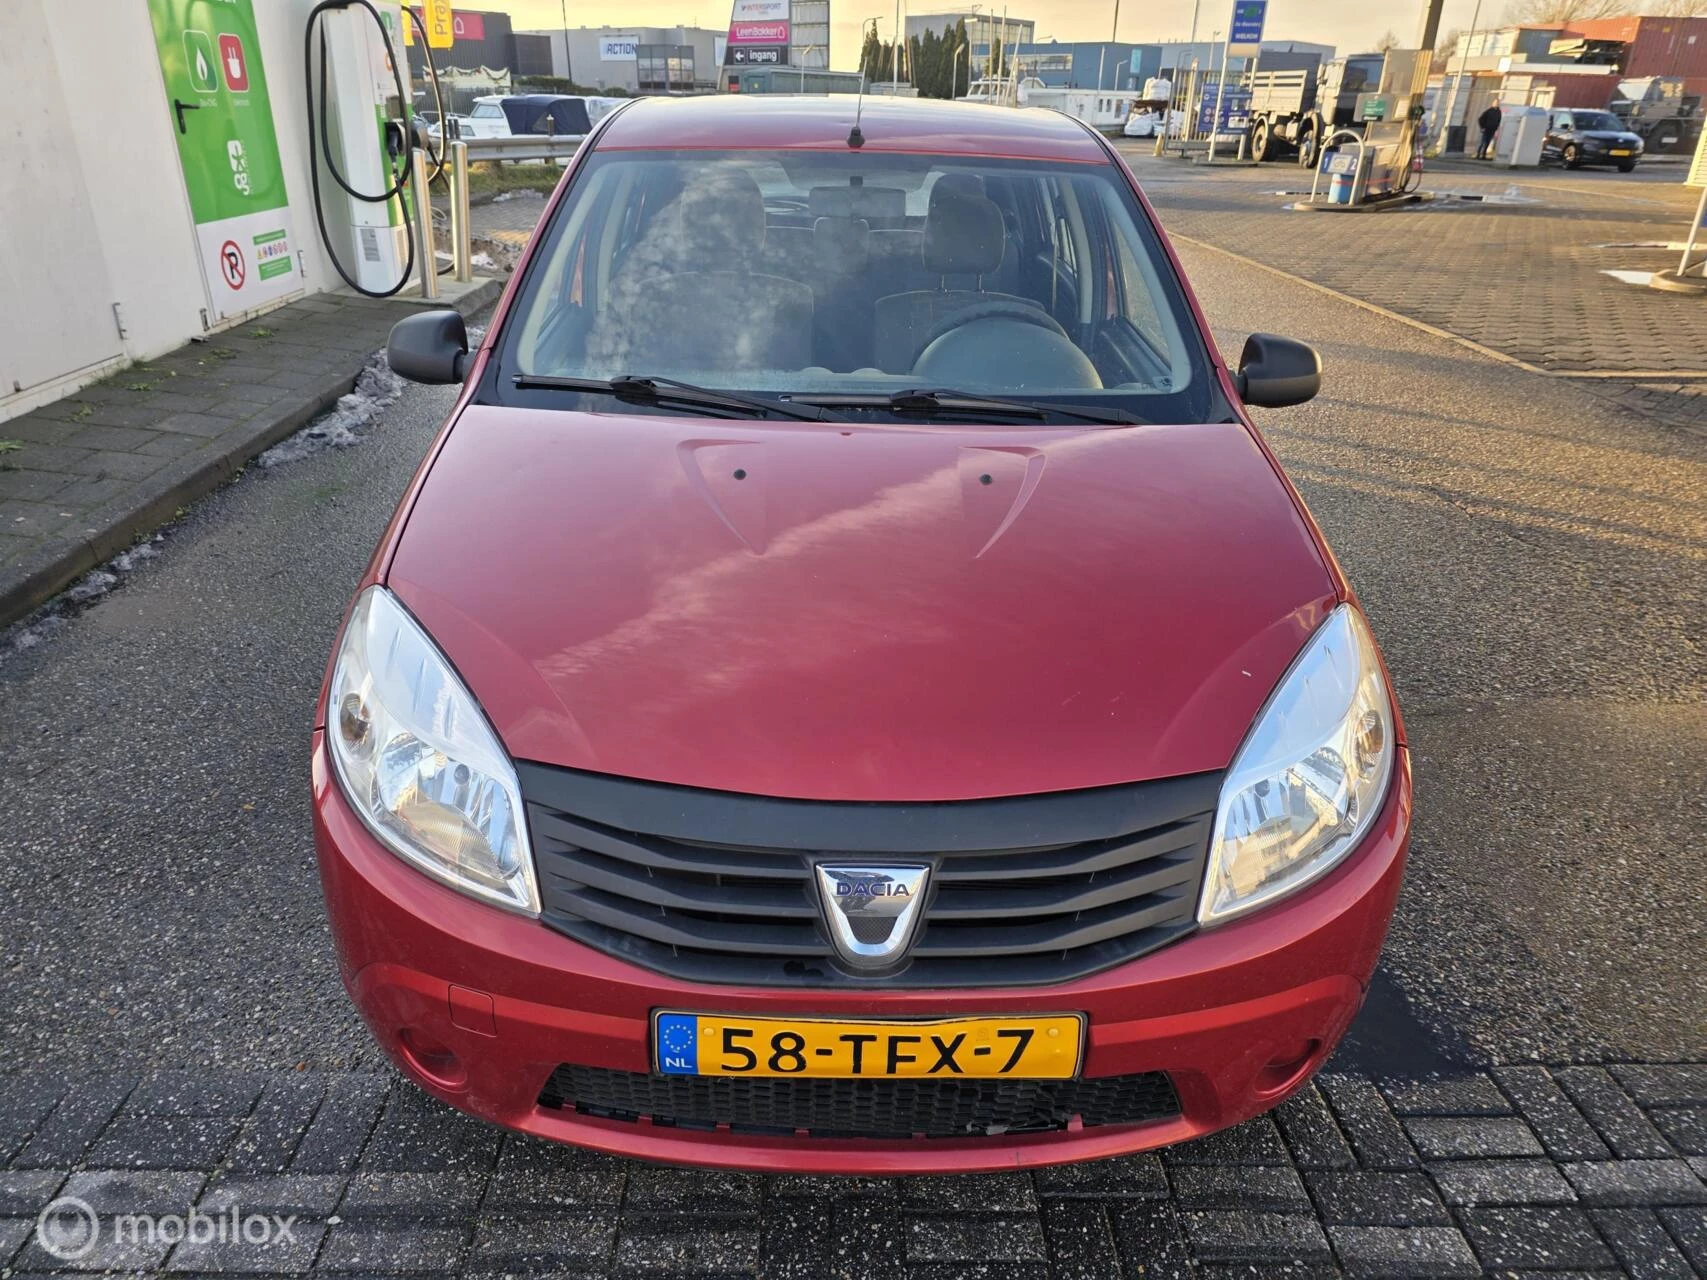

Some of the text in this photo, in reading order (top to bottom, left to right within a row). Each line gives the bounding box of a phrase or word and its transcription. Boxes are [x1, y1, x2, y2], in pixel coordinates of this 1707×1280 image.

[607, 43, 638, 54] ACTION
[750, 50, 777, 62] ingang
[1323, 157, 1330, 169] 1
[1350, 158, 1358, 170] 2
[836, 882, 910, 896] DACIA
[721, 1027, 1035, 1074] 58-TFX-7
[665, 1057, 693, 1069] NL
